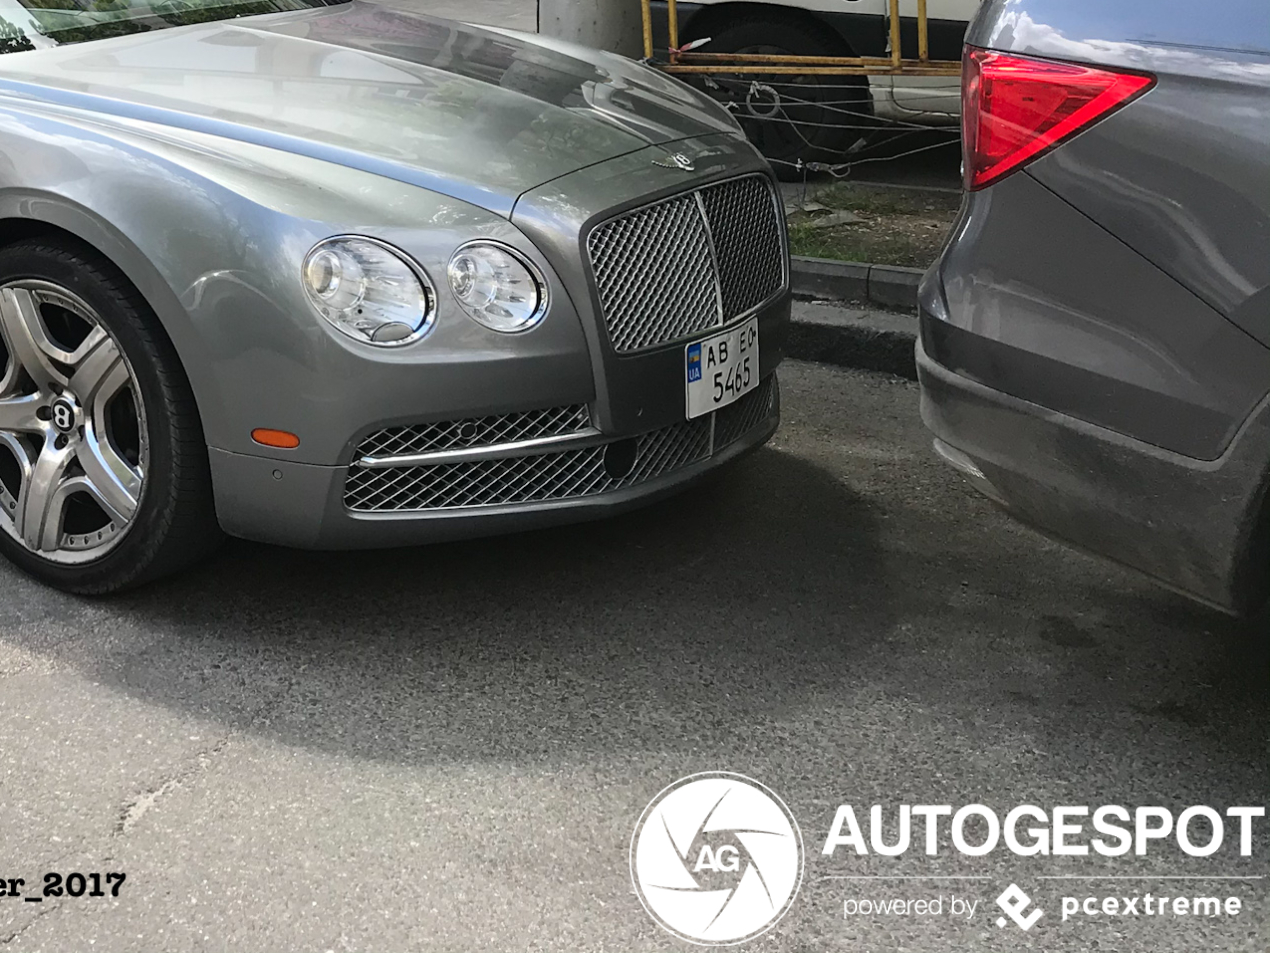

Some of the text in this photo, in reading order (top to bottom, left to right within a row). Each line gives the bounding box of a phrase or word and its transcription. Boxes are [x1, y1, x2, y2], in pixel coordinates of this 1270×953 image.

[707, 341, 729, 369] AB
[688, 367, 701, 381] UA
[713, 356, 750, 403] 5465
